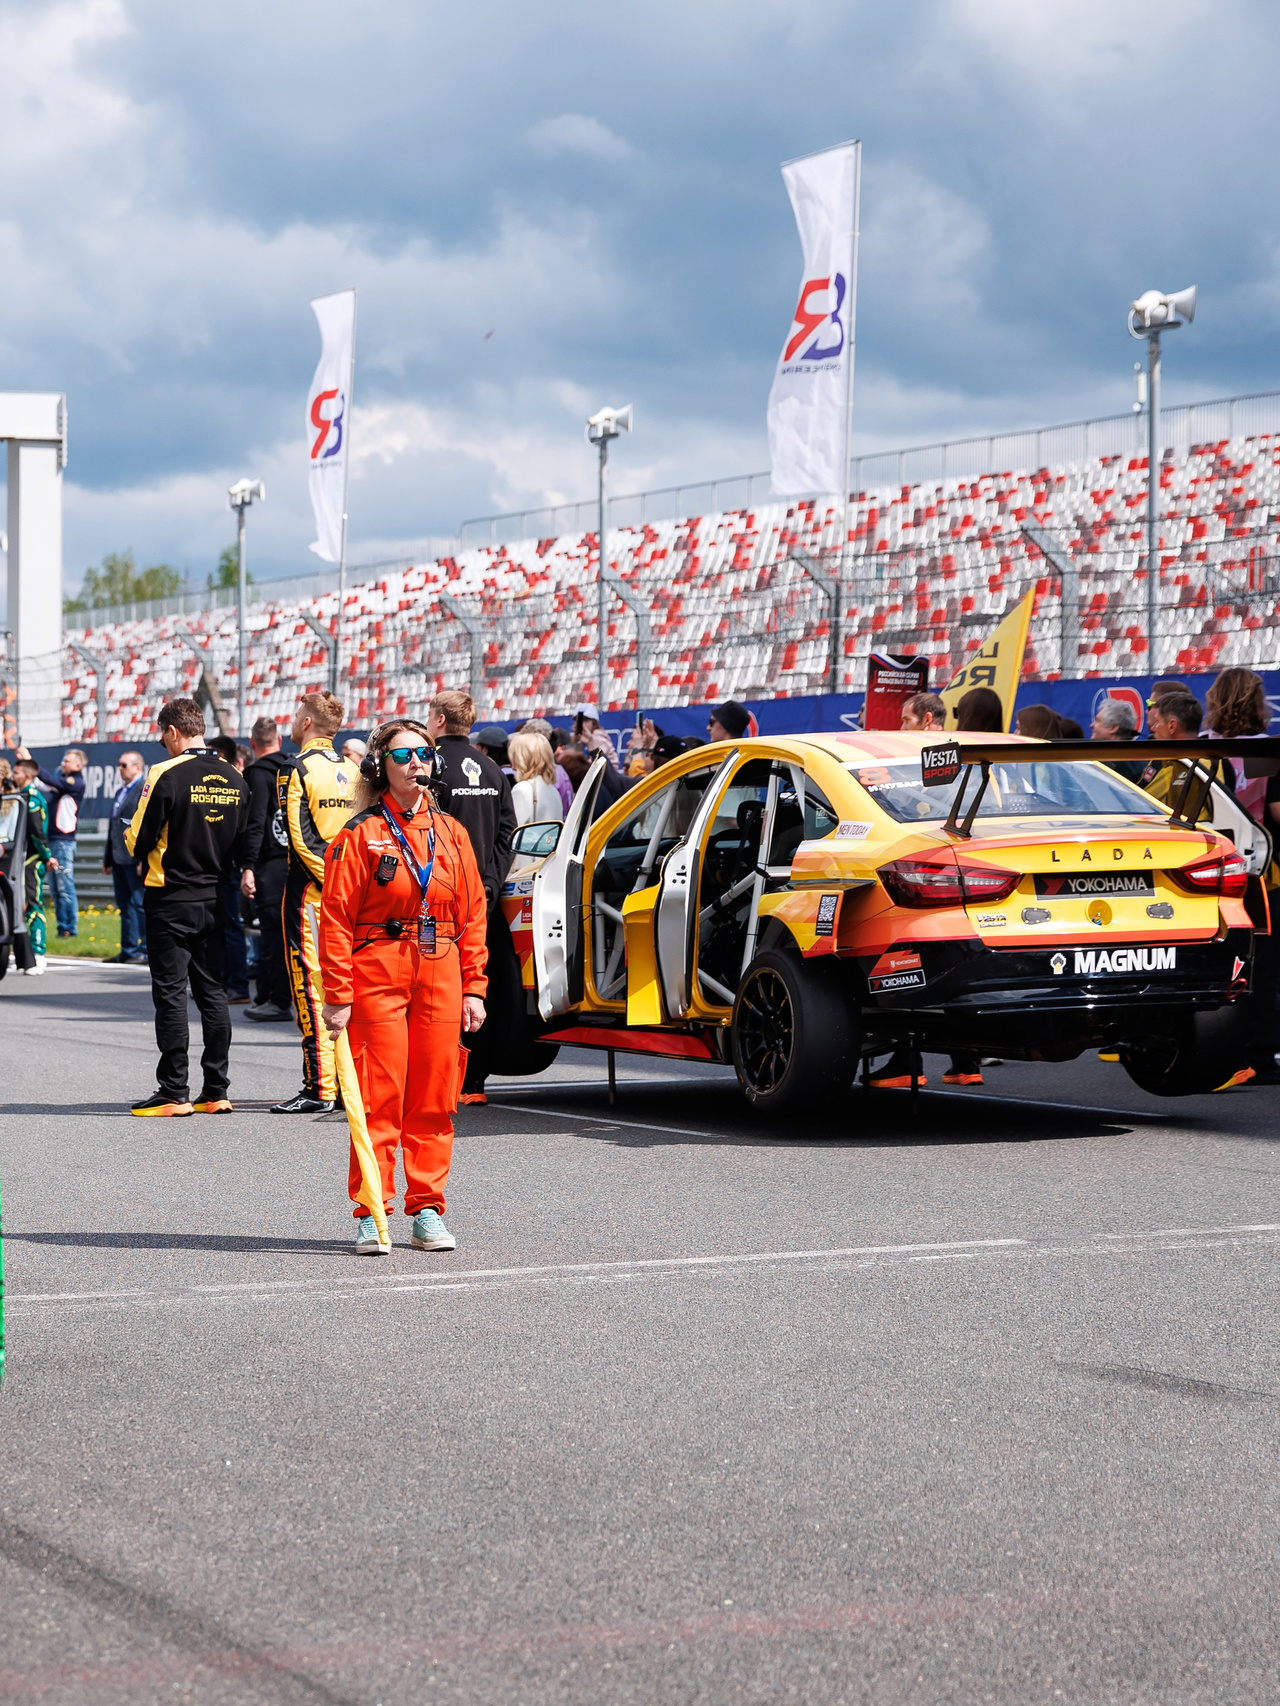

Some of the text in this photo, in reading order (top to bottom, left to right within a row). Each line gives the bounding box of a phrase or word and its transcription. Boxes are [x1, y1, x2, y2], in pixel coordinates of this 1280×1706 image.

[923, 750, 958, 768] VESTA
[857, 767, 892, 786] 8
[923, 766, 958, 779] SPORT
[190, 785, 240, 796] LADA SPORT
[451, 787, 499, 797] РОСНЕФТЬ
[867, 780, 924, 793] И.ЧУБАР
[190, 794, 240, 806] ROSNEFT
[318, 798, 354, 809] ROSNE
[837, 824, 871, 836] MEN TODAY
[1051, 846, 1154, 863] LADA
[1068, 876, 1148, 894] YOKOHAMA
[1074, 947, 1177, 974] MAGNUM
[881, 974, 920, 988] YOKOHAMA
[290, 946, 314, 1037] ROSNEFT
